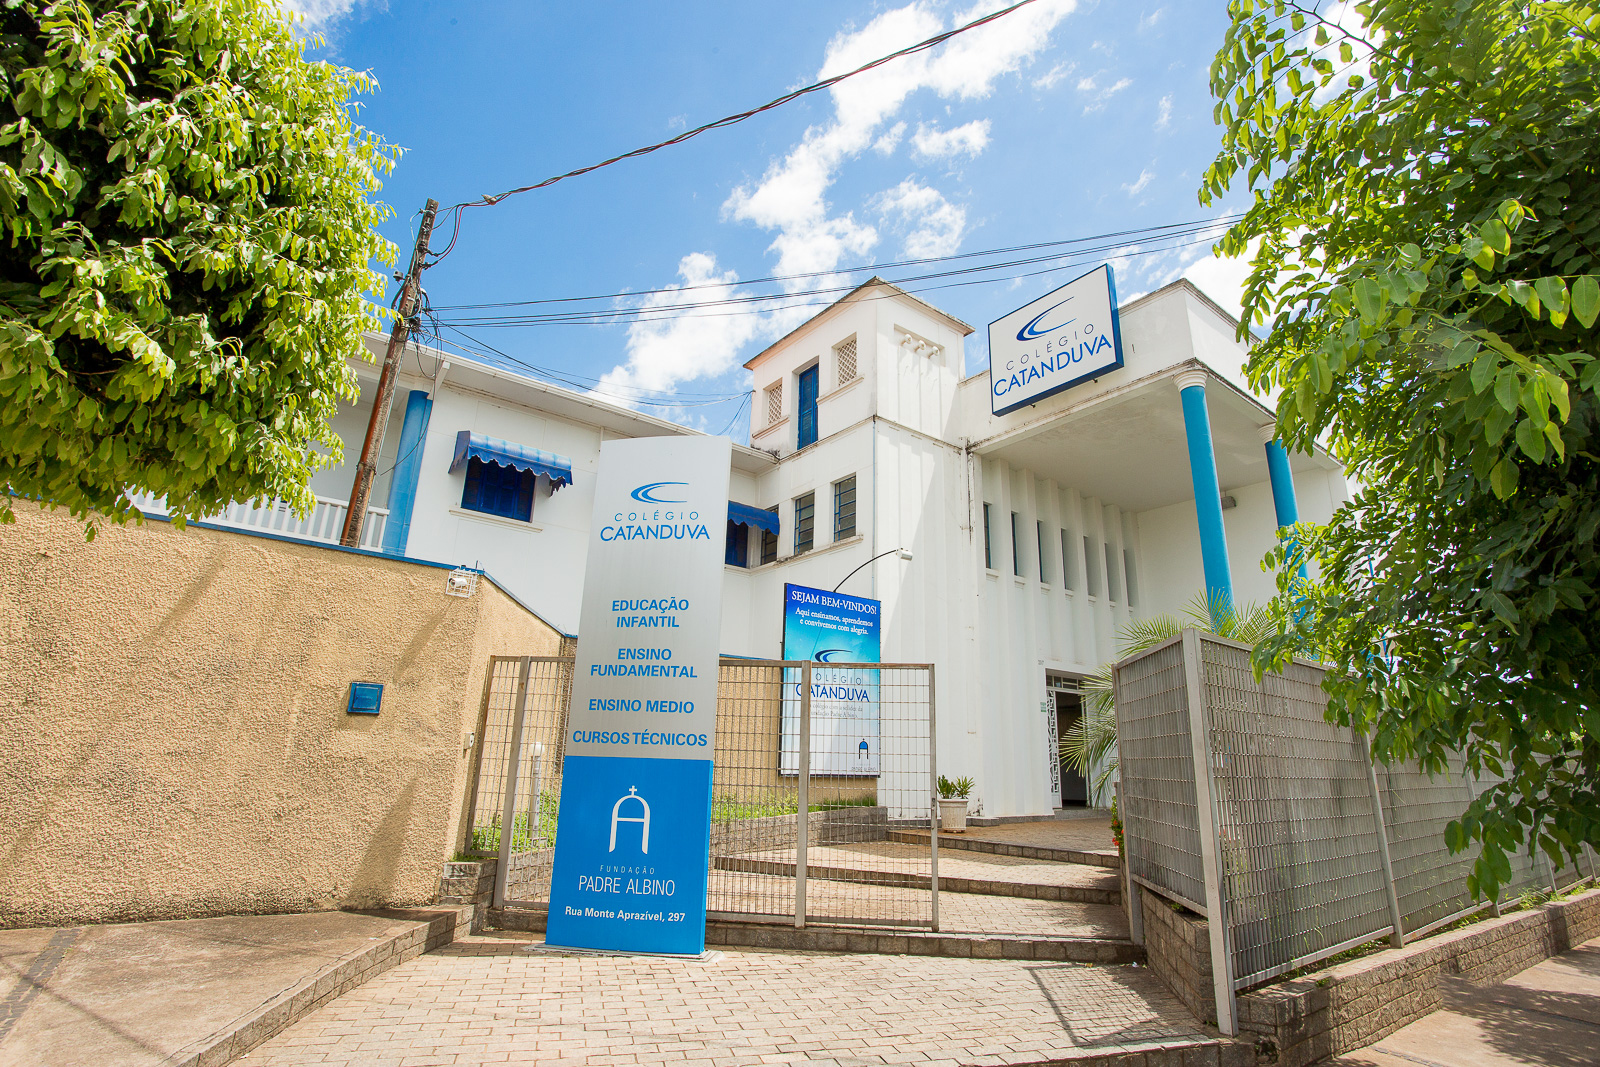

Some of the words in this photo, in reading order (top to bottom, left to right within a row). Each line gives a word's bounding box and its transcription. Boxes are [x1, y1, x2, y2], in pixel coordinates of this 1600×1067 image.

[1006, 323, 1094, 371] COLÉGIO
[993, 333, 1112, 396] CATANDUVA
[614, 510, 699, 522] COLÉGIO
[600, 524, 710, 541] CATANDUVA
[611, 596, 689, 614] EDUCAÇÃO
[791, 590, 820, 605] SEJAM
[821, 595, 877, 615] BEM-VINDOS!
[616, 615, 680, 628] INFANTIL
[795, 607, 810, 618] Aqui
[810, 611, 841, 623] ensinamos,
[842, 617, 874, 627] aprendemos
[804, 619, 837, 630] convivemos
[850, 625, 869, 636] alegria.
[617, 648, 672, 661] ENSINO
[590, 664, 698, 678] FUNDAMENTAL
[815, 673, 862, 685] OLÉGIO
[588, 698, 642, 712] ENSINO
[645, 700, 695, 714] MEDIO
[572, 730, 630, 745] CURSOS
[632, 729, 708, 747] TÉCNICOS
[599, 864, 655, 875] FUNDAÇÃO
[578, 875, 622, 894] PADRE
[625, 878, 675, 896] ALBINO
[565, 906, 582, 916] Rua
[584, 908, 615, 919] Monte
[617, 910, 665, 923] Aprazível,
[667, 912, 686, 922] 297
